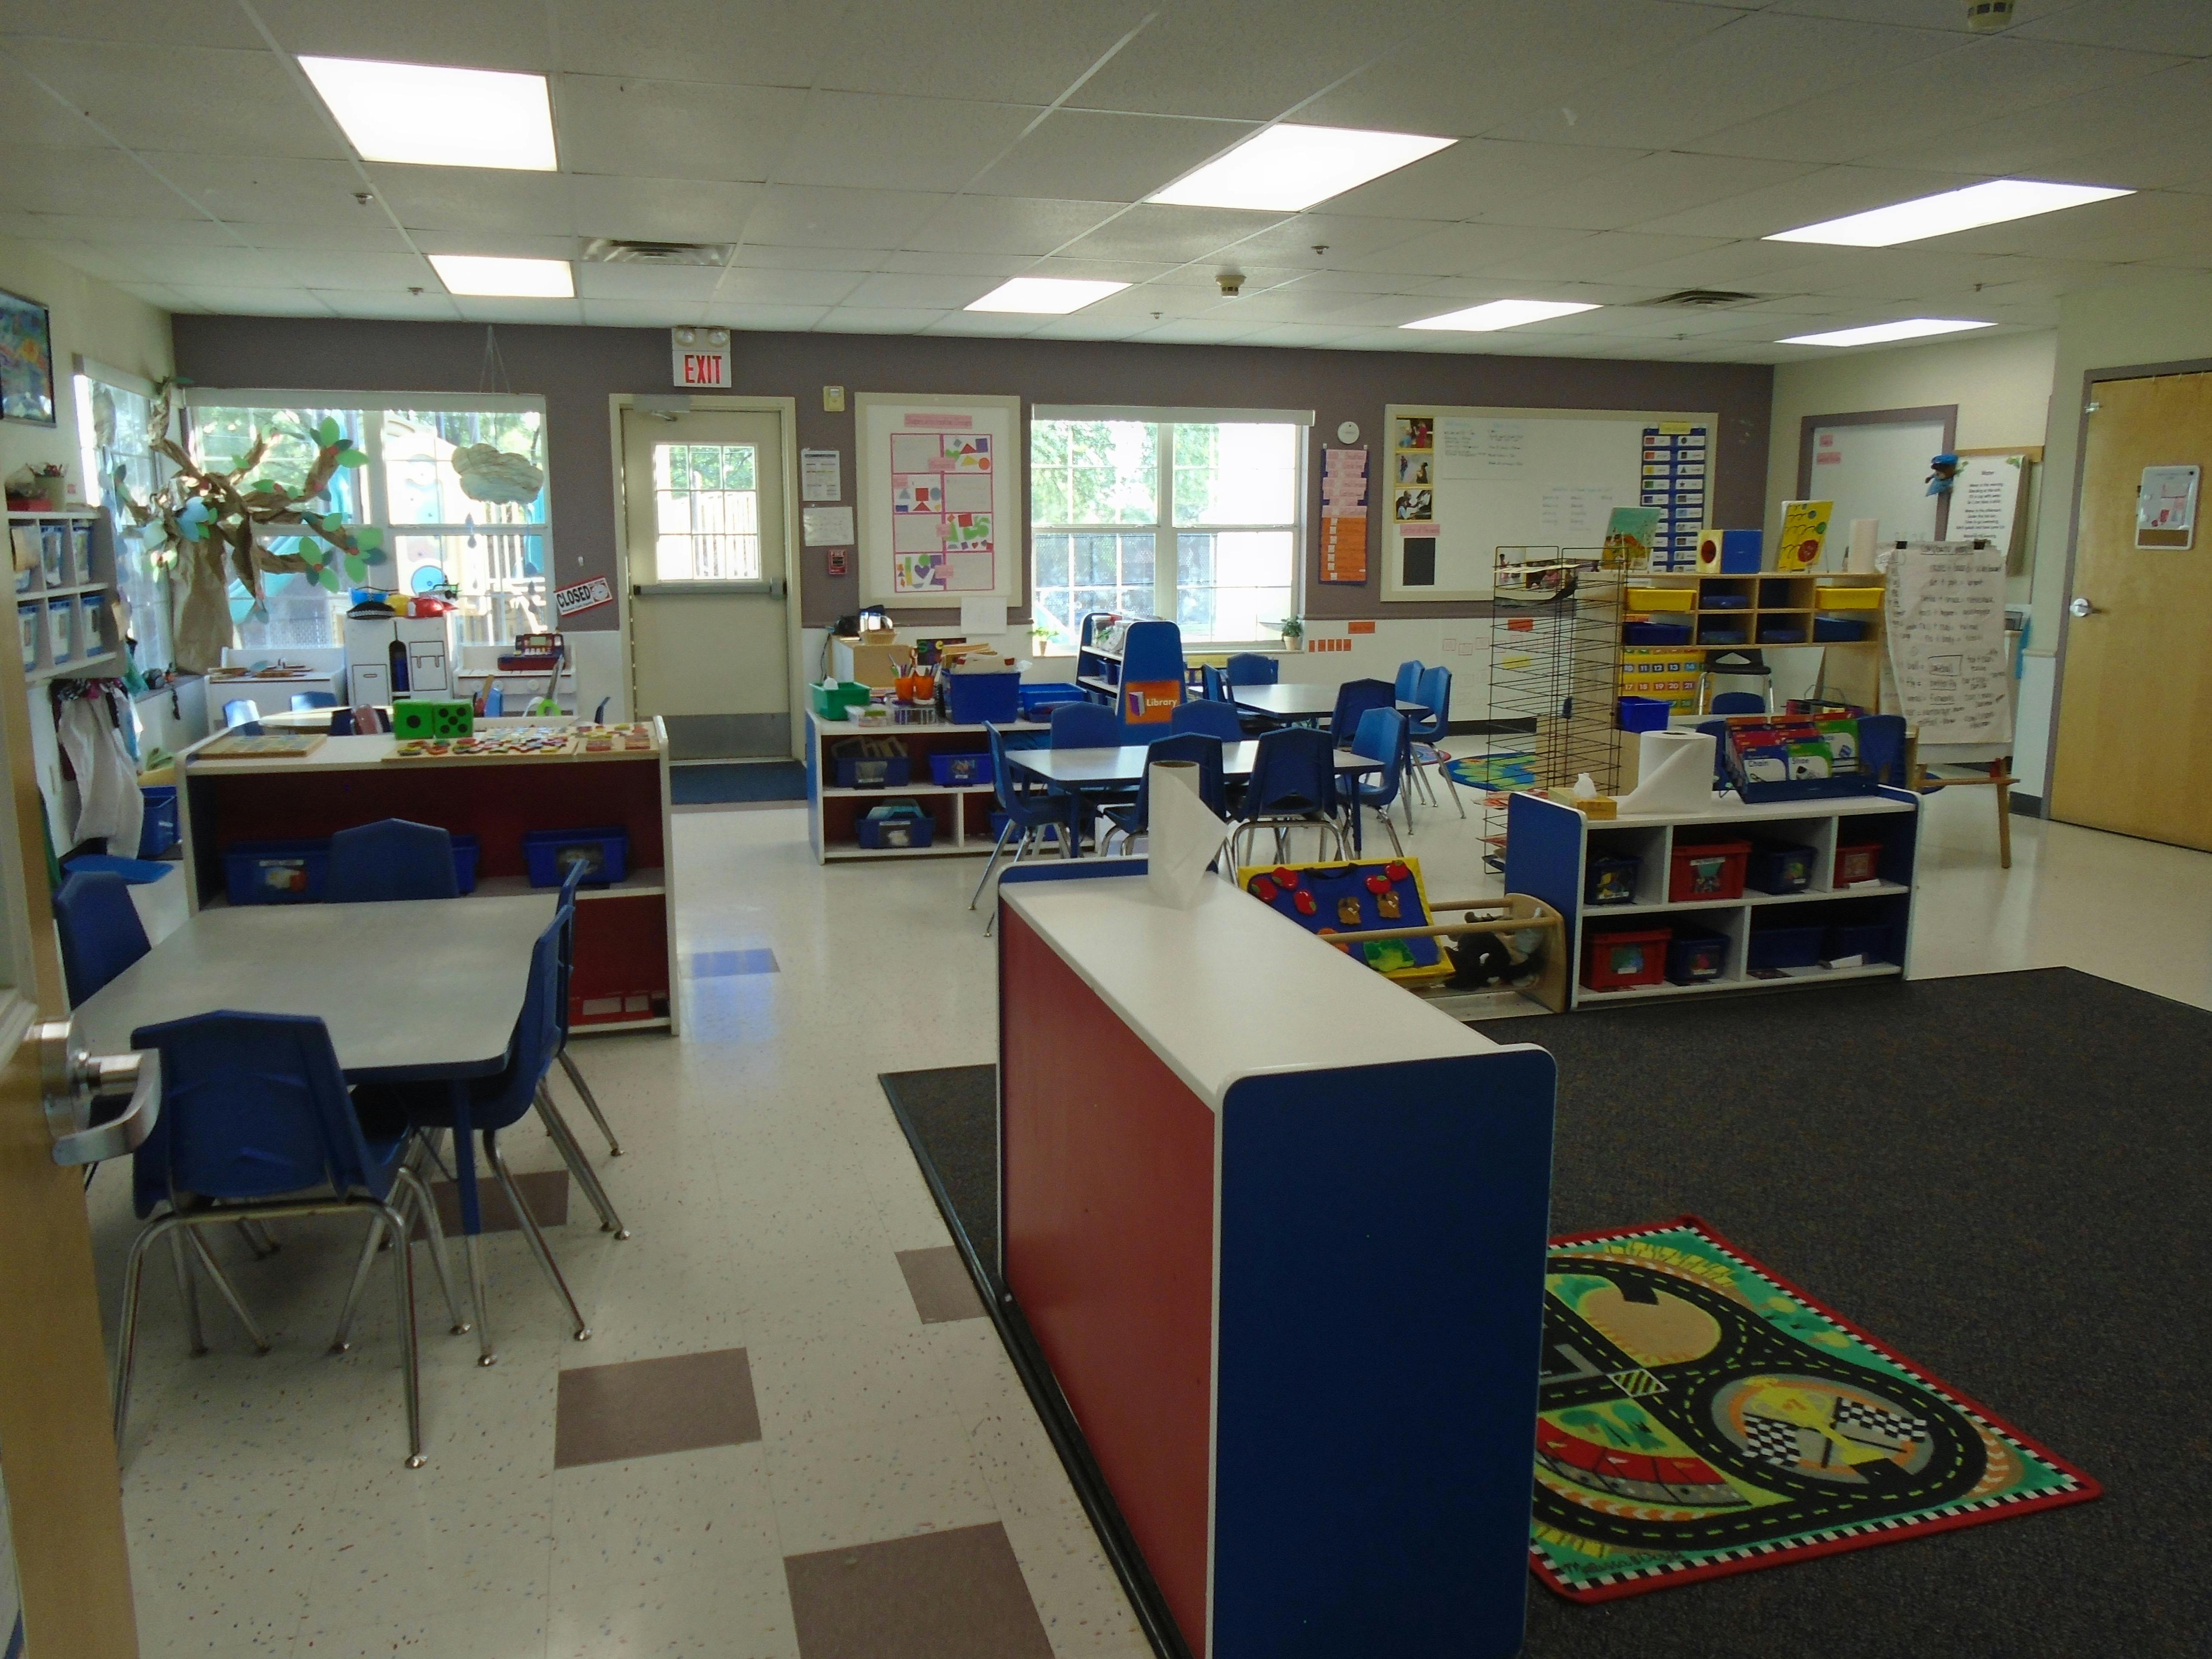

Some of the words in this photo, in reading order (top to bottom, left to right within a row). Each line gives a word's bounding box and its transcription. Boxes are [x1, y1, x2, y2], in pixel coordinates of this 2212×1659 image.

[684, 355, 722, 384] EXIT
[556, 585, 591, 608] CLOSED
[1146, 698, 1177, 708] Library
